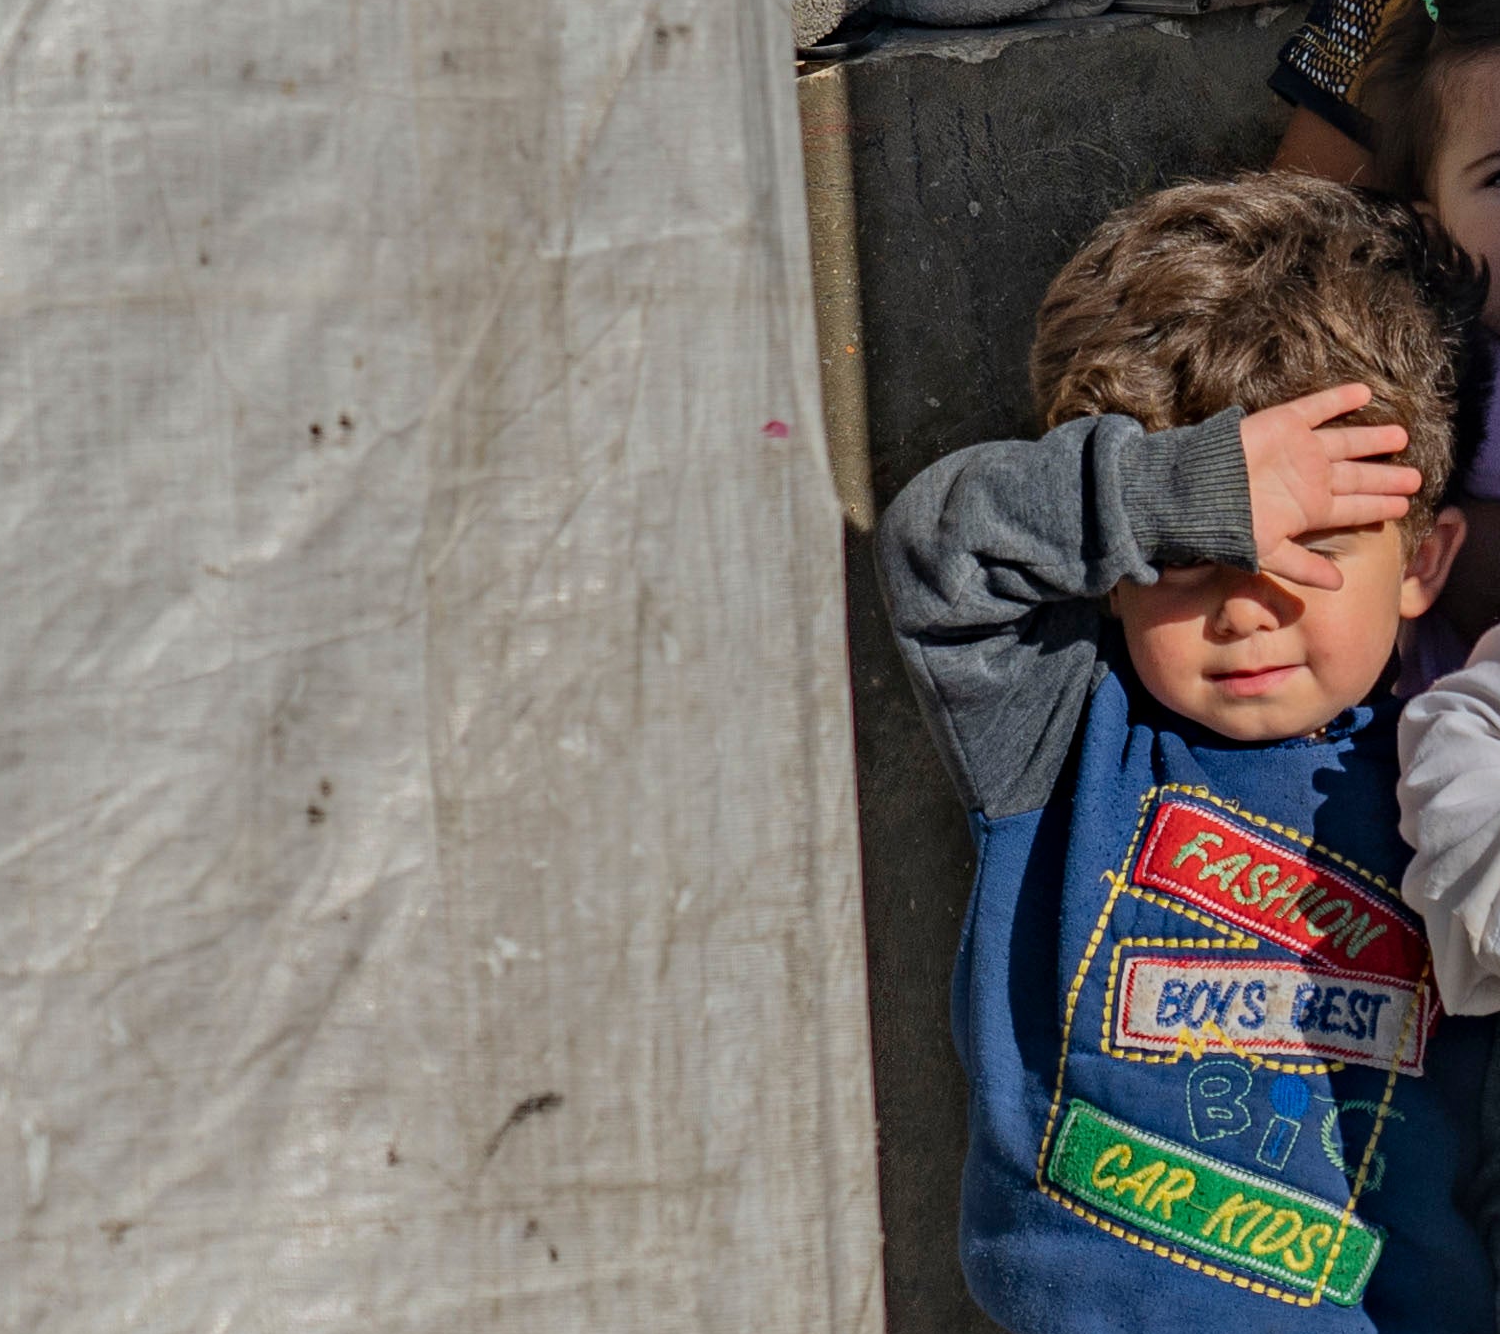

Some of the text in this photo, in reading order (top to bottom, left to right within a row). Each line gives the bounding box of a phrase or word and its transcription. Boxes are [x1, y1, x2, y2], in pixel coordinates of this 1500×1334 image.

[1172, 832, 1388, 959] FASHION
[1156, 978, 1391, 1041] BOYS BEST
[1091, 1144, 1334, 1272] CAR KIDS
